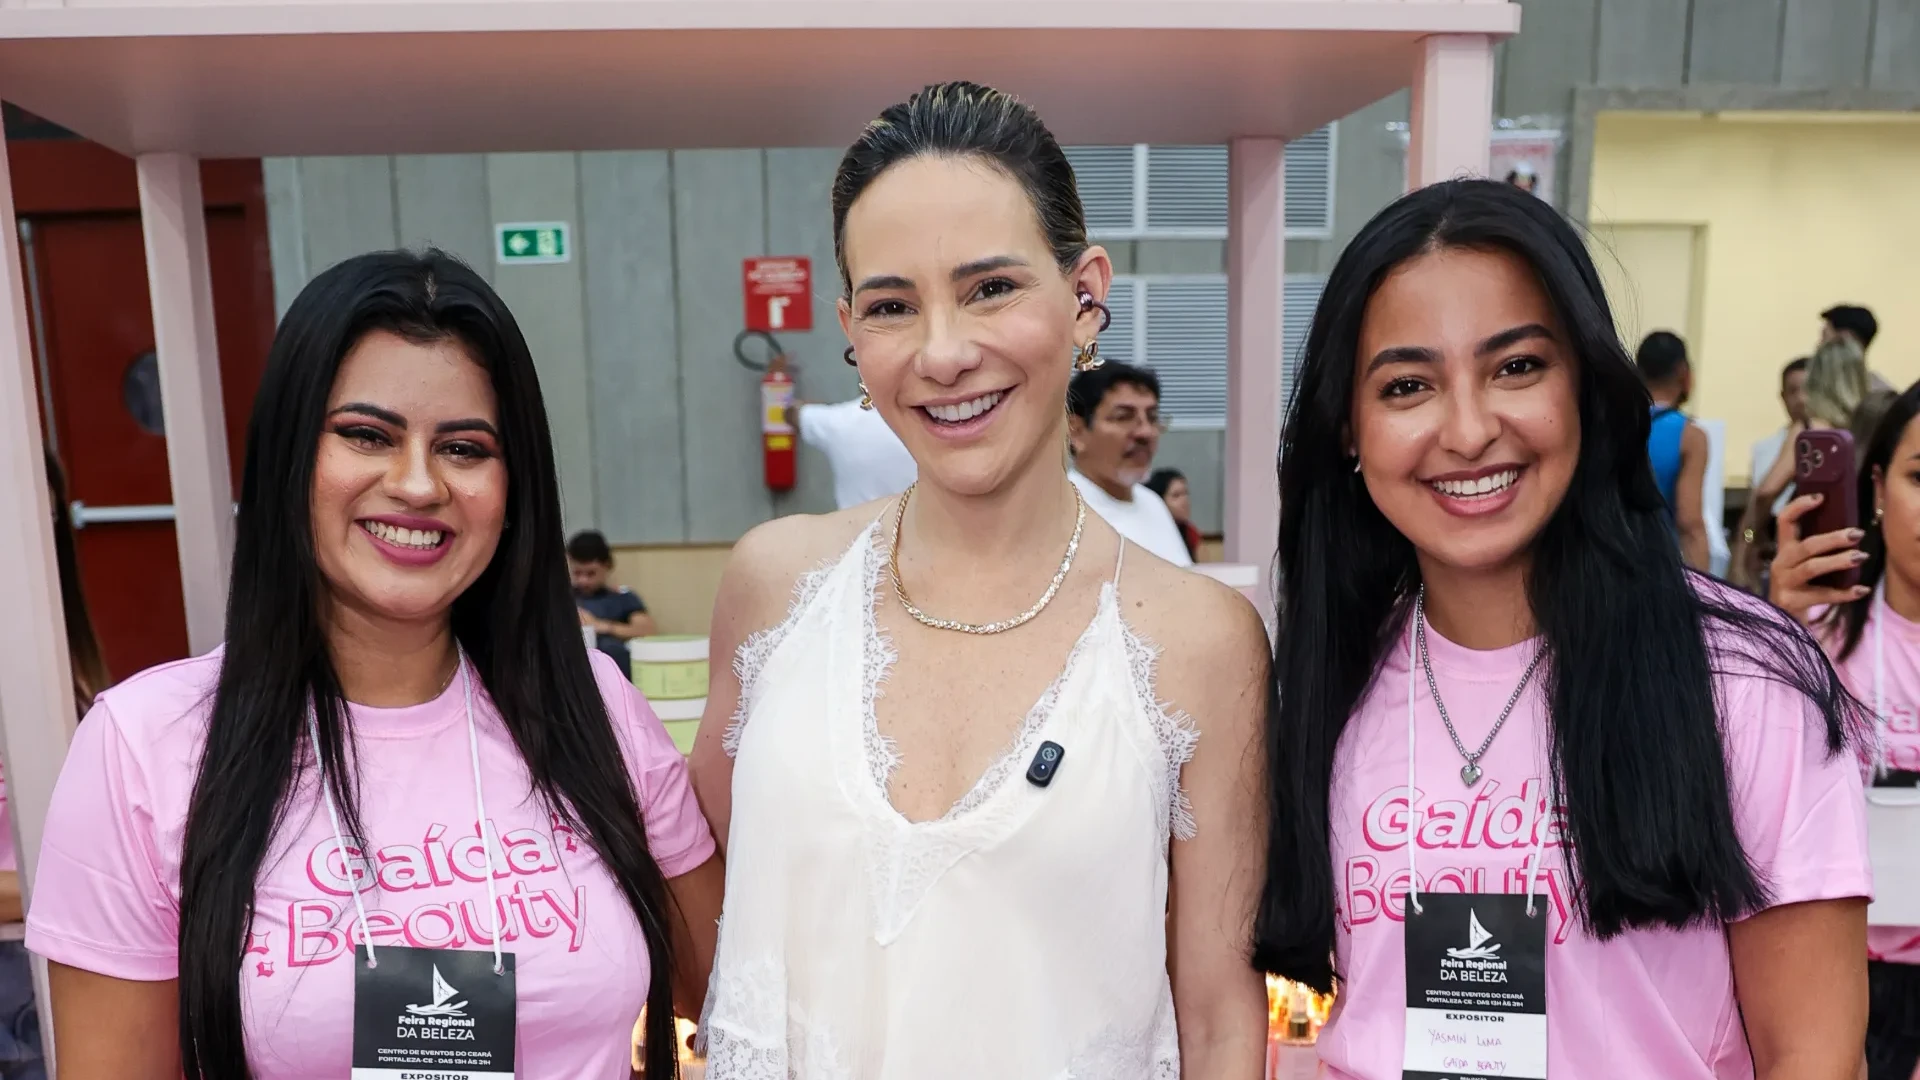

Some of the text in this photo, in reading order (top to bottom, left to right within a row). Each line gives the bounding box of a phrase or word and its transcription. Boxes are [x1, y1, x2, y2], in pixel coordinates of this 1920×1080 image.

[1363, 778, 1577, 852] Gaída
[306, 818, 558, 896] Gaída
[288, 880, 586, 967] Beauty
[1440, 958, 1507, 971] Feira Regional
[1440, 969, 1508, 983] DA BELEZA
[398, 1015, 475, 1028] Feira Regional
[1445, 1013, 1505, 1022] EXPOSITOR
[396, 1026, 476, 1041] DA BELEZA
[1427, 1028, 1467, 1046] YASMIN
[408, 1048, 420, 1056] DE
[420, 1049, 455, 1057] EVENTOS
[467, 1049, 492, 1058] CEARÁ
[467, 1057, 478, 1065] ÀS
